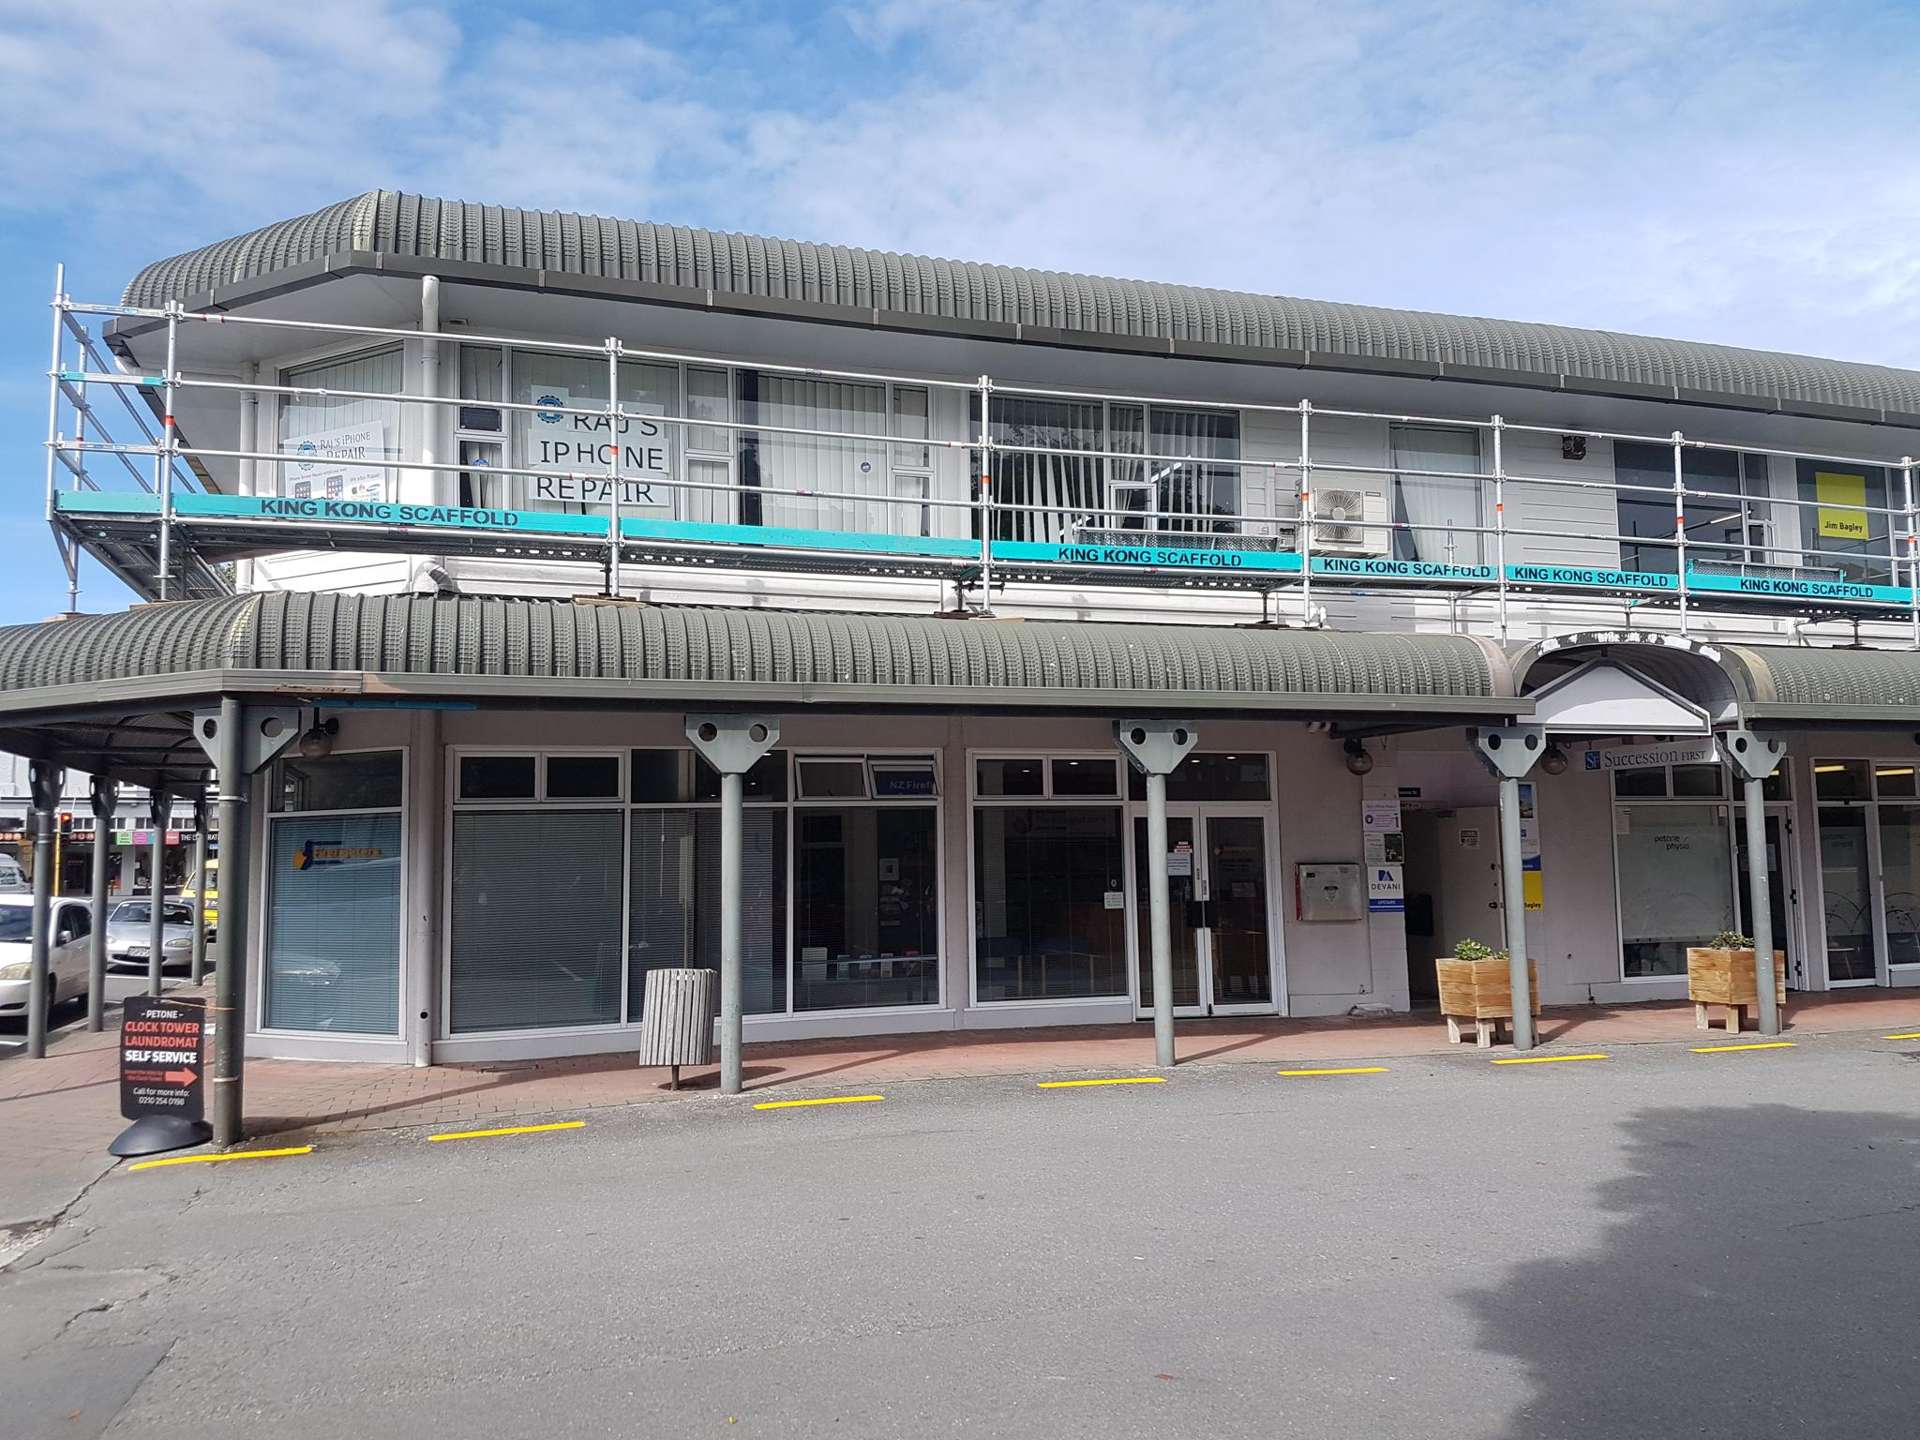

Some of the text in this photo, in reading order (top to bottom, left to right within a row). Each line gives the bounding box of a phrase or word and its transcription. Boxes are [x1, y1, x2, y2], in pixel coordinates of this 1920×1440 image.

[574, 412, 658, 437] RAJS
[541, 440, 664, 471] IPHONE
[537, 476, 654, 504] REPAIR
[261, 499, 518, 526] KING KONG SCAFFOLD
[1824, 521, 1863, 533] Jim Bagley
[1058, 547, 1242, 567] KING KONG SCAFFOLD
[1323, 558, 1491, 578] KING KONG SCAFFOLD
[1514, 567, 1669, 587] KING KONG SCAFFOLD
[1740, 579, 1874, 598] KING KONG SCAFFOLD
[1604, 750, 1678, 768] Succession
[1681, 750, 1707, 761] FIRST
[889, 780, 905, 789] NZ
[1371, 883, 1401, 891] DEVANI
[146, 1009, 179, 1019] PETONE
[125, 1021, 200, 1034] CLOCK TOWER
[125, 1035, 199, 1048] LAUNDROMAT
[125, 1049, 198, 1064] SELF SERVICE
[133, 1087, 146, 1095] Call
[146, 1087, 157, 1096] for
